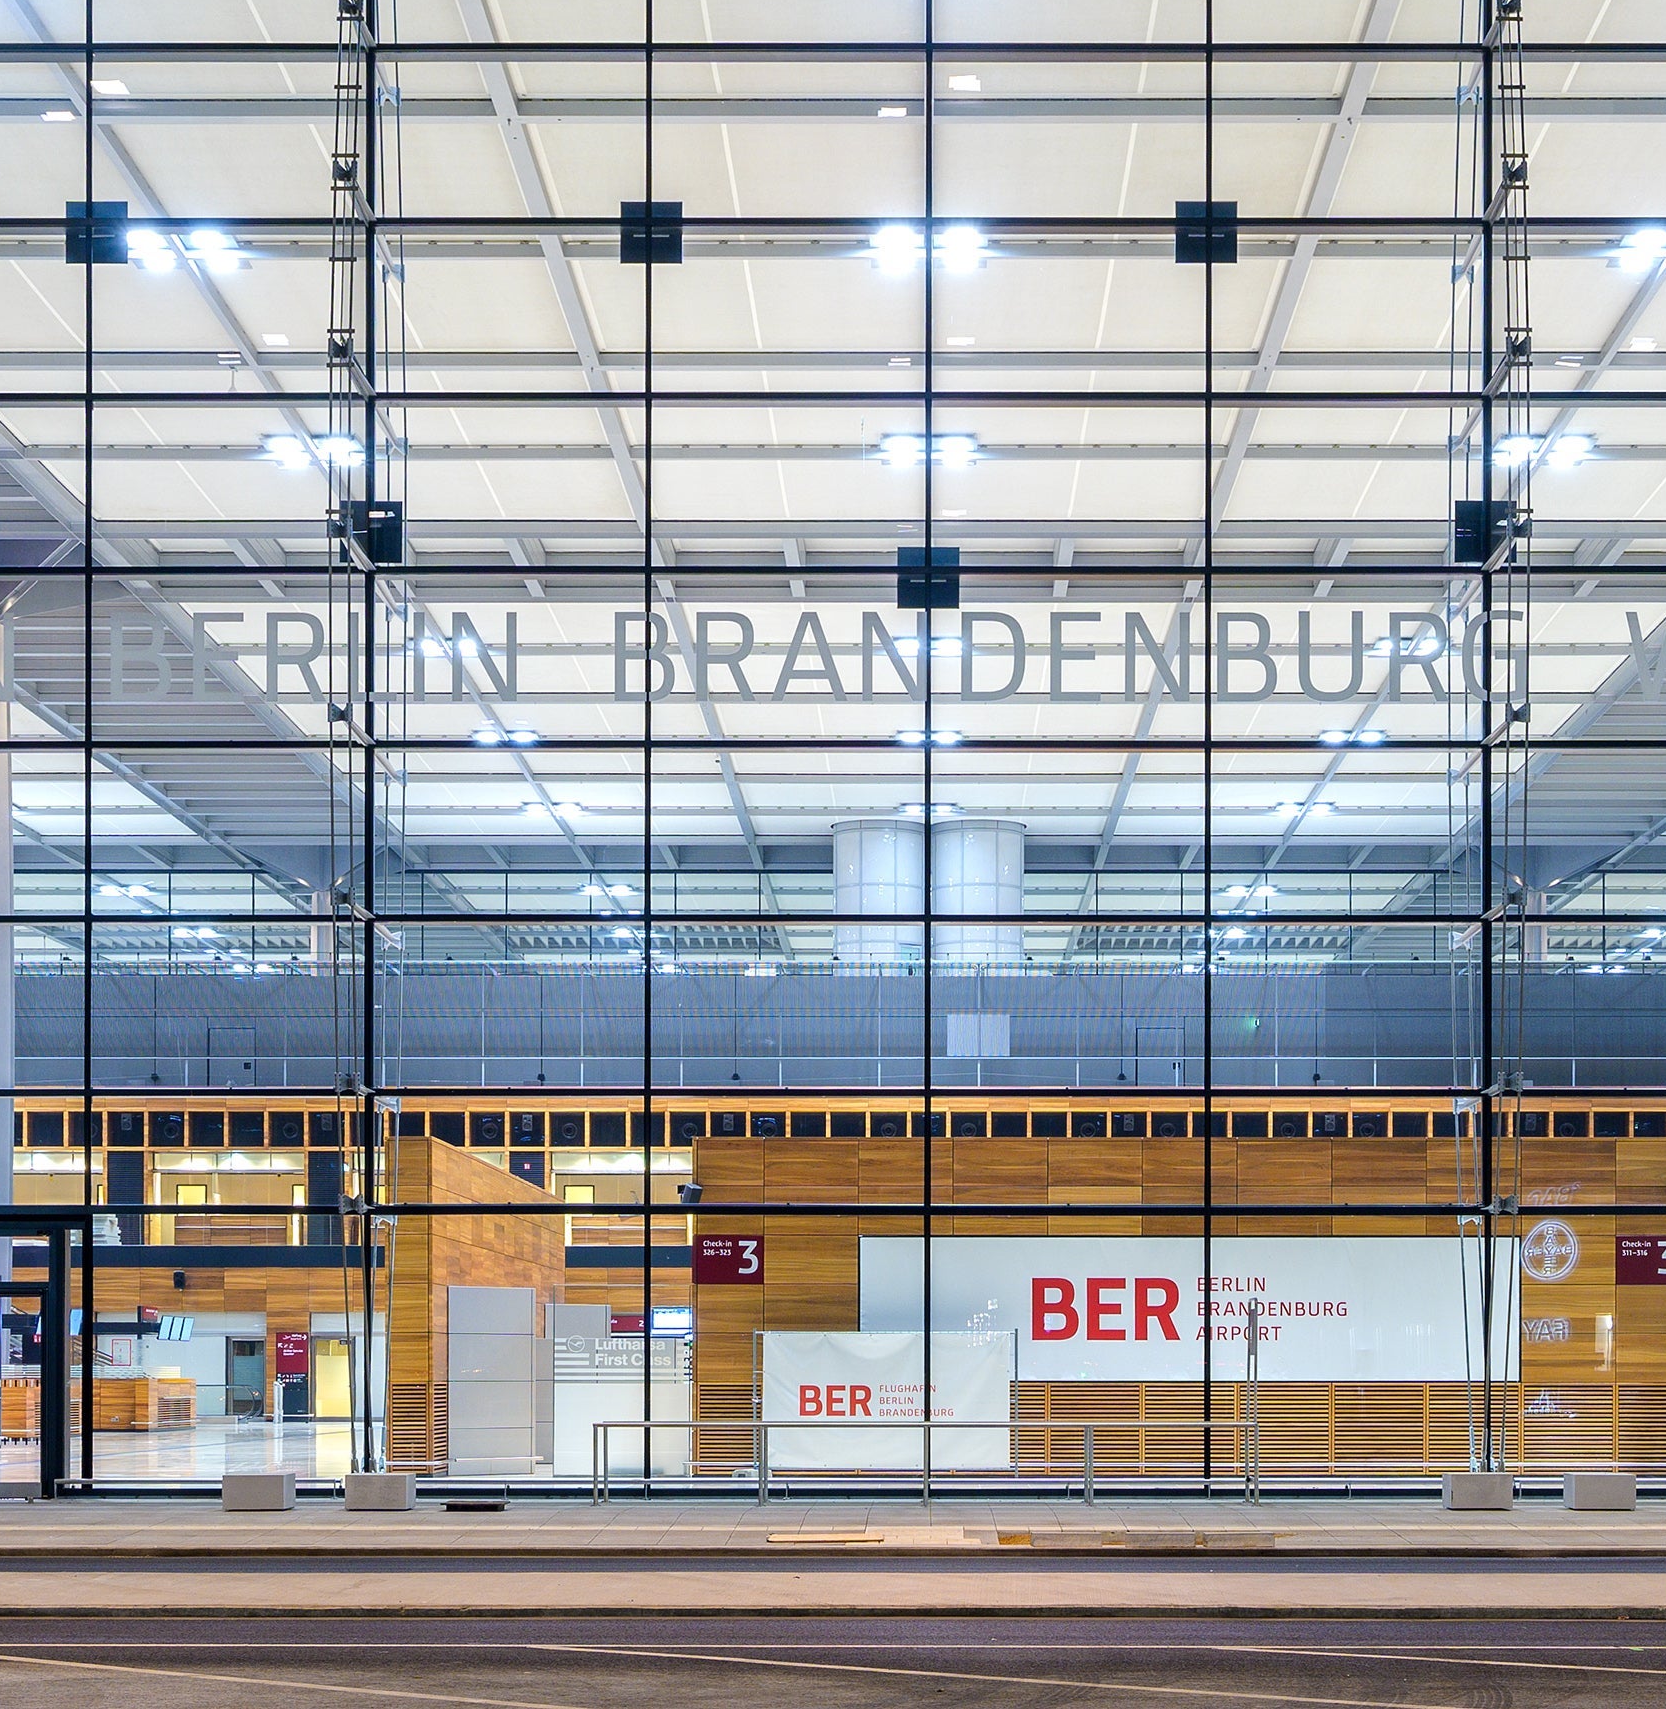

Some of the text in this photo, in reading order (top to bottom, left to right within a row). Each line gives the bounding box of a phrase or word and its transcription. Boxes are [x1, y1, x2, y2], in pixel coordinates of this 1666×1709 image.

[109, 611, 518, 703] BERLIN
[614, 610, 1529, 703] BRANDENBURG
[738, 1240, 760, 1274] 3
[1032, 1277, 1266, 1341] BER BERLIN
[1197, 1301, 1348, 1316] BRANDENBURG
[594, 1353, 672, 1366] First Cass
[799, 1384, 936, 1417] BER FLUGHAFN
[879, 1396, 914, 1405] BERLIN
